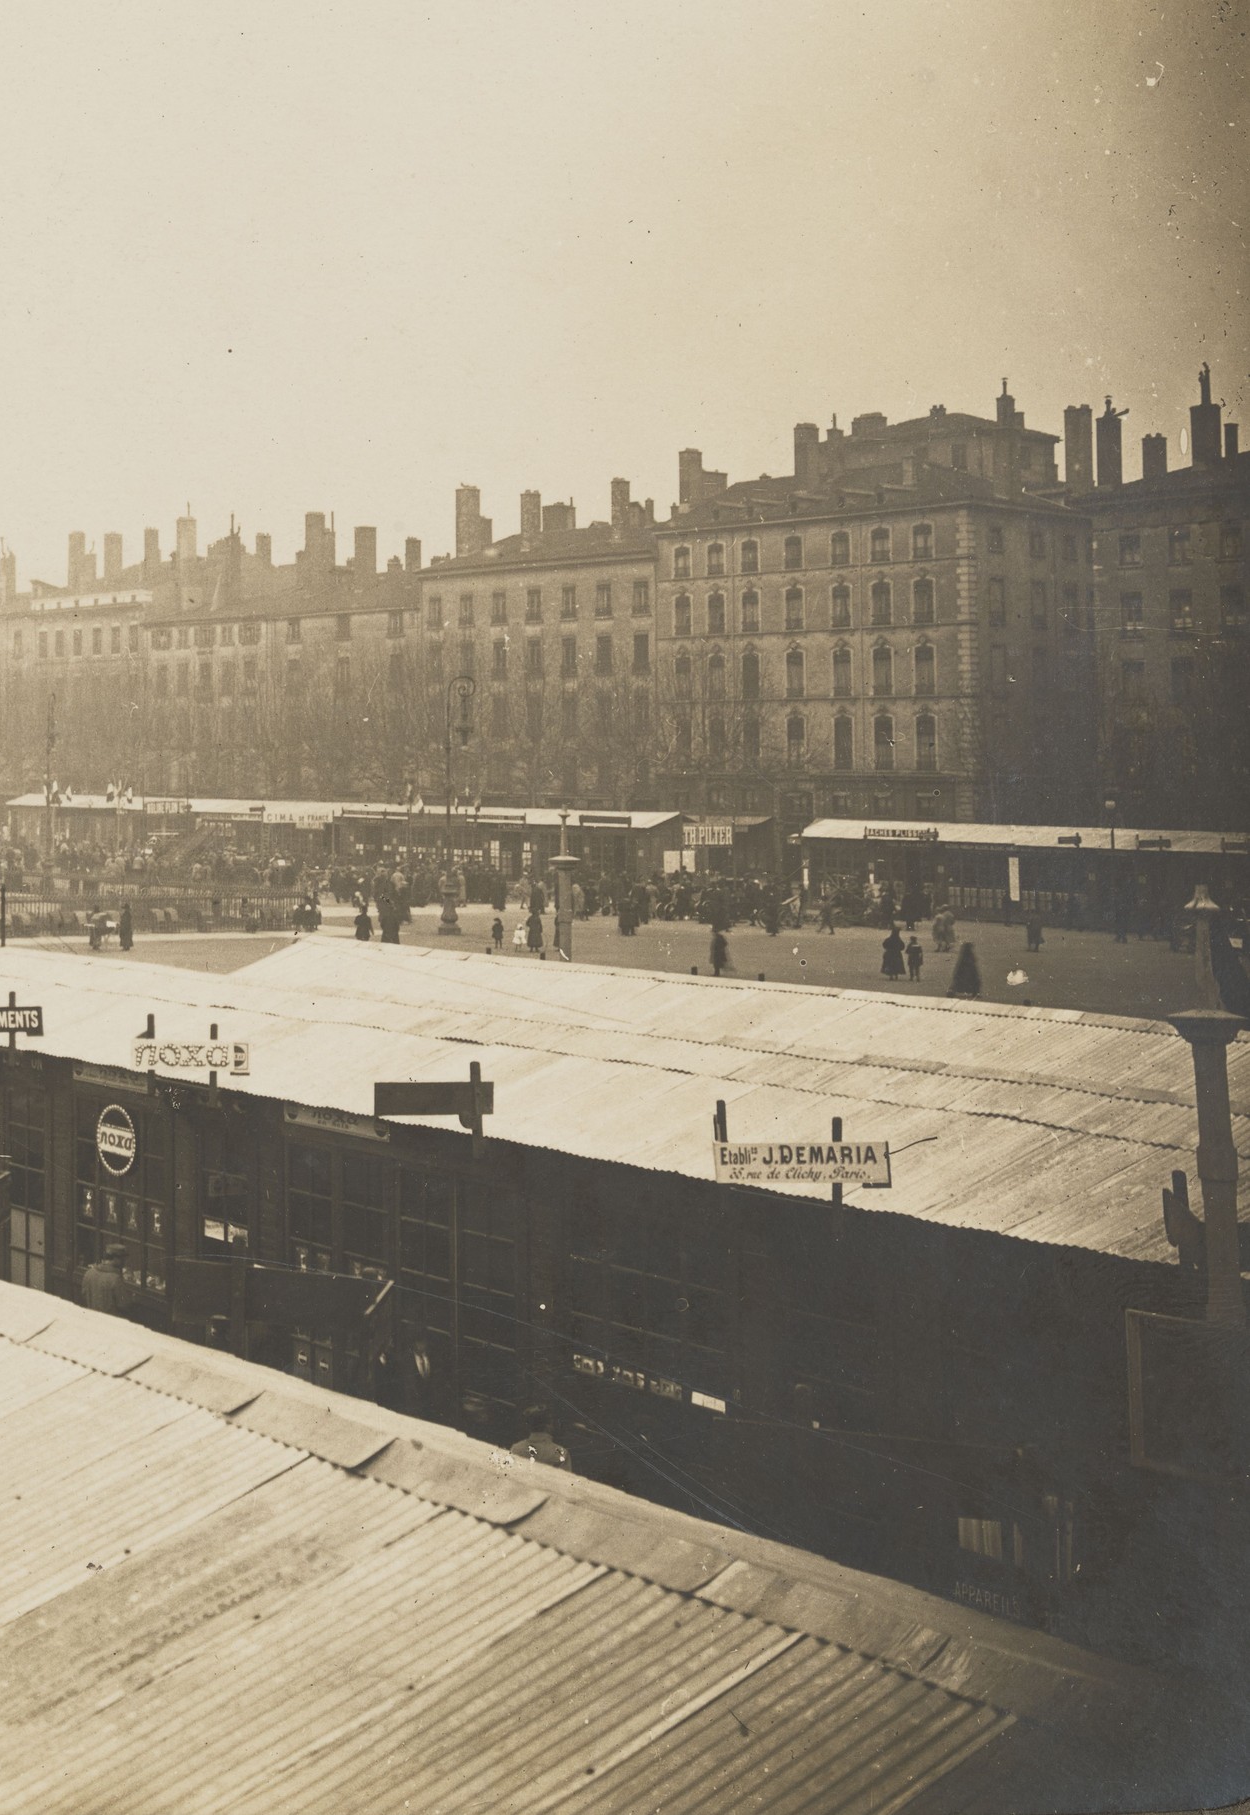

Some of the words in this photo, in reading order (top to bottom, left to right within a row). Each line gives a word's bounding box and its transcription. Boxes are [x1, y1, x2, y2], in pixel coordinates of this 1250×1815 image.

[699, 826, 733, 845] PILTER
[134, 1043, 230, 1068] noxa
[99, 1131, 133, 1151] noxa
[766, 1167, 780, 1179] de
